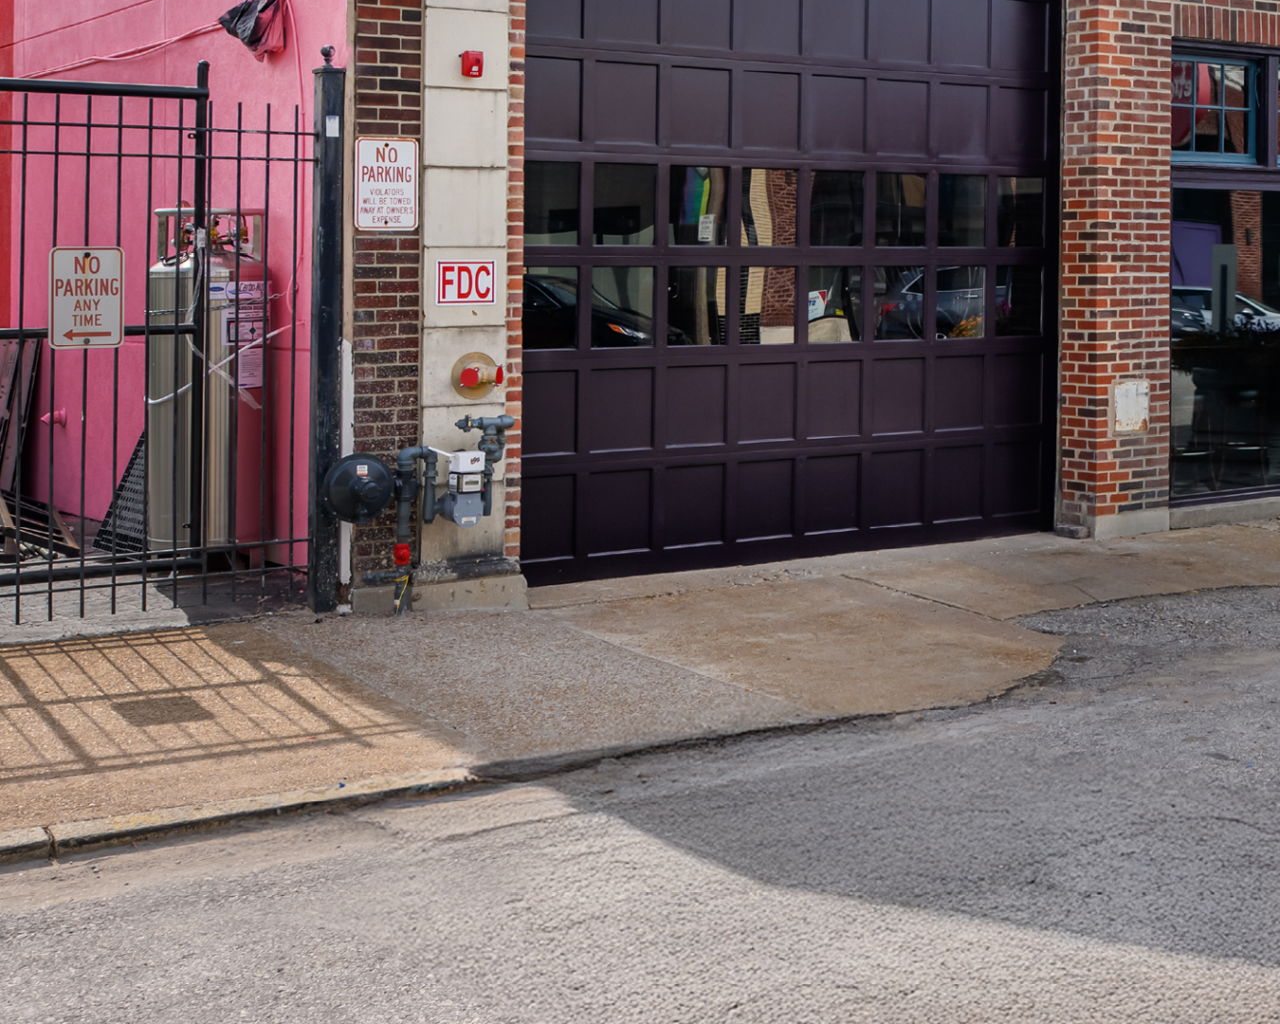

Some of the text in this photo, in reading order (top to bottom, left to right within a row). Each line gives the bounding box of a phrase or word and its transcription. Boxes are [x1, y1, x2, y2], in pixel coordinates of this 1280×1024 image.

[376, 147, 398, 163] NO
[361, 166, 412, 183] PARKING
[372, 216, 402, 224] EXPENSE
[74, 256, 101, 274] NO
[55, 278, 119, 297] PARKING
[442, 265, 491, 299] FDC
[74, 299, 101, 311] ANY
[72, 314, 102, 327] TIME
